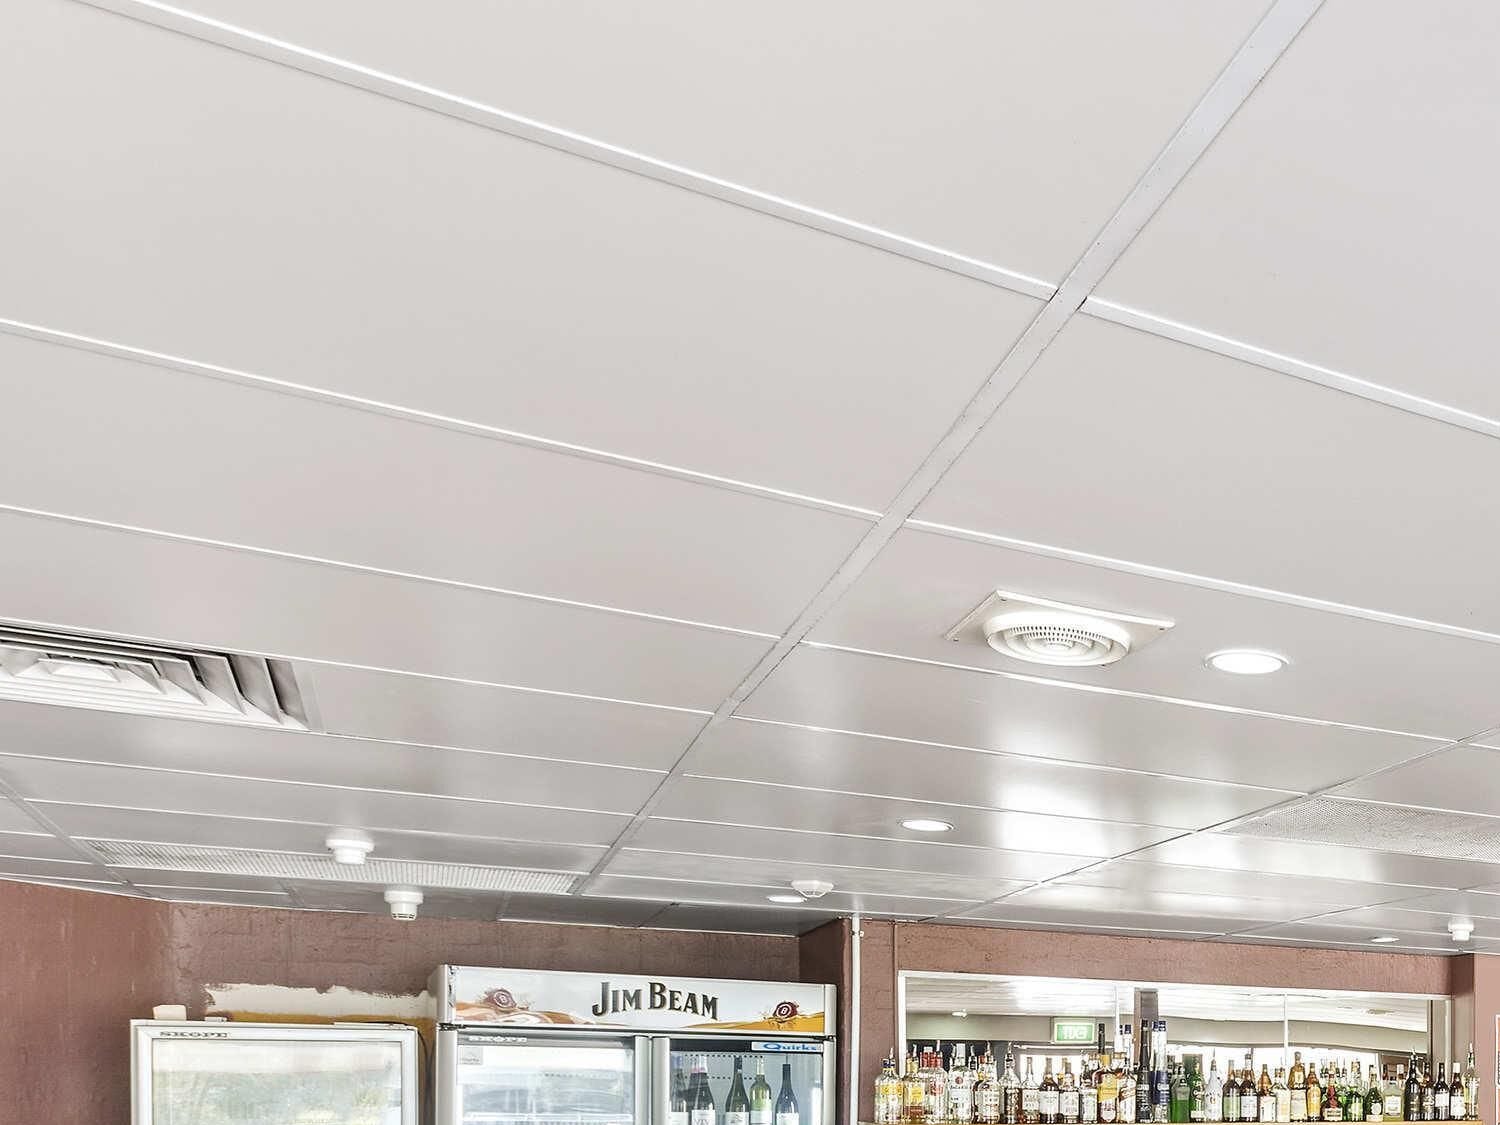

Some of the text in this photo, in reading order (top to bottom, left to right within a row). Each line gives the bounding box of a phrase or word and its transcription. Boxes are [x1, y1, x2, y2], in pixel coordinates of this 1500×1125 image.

[592, 982, 719, 1021] JIM BEAM
[763, 1042, 817, 1051] Quirks
